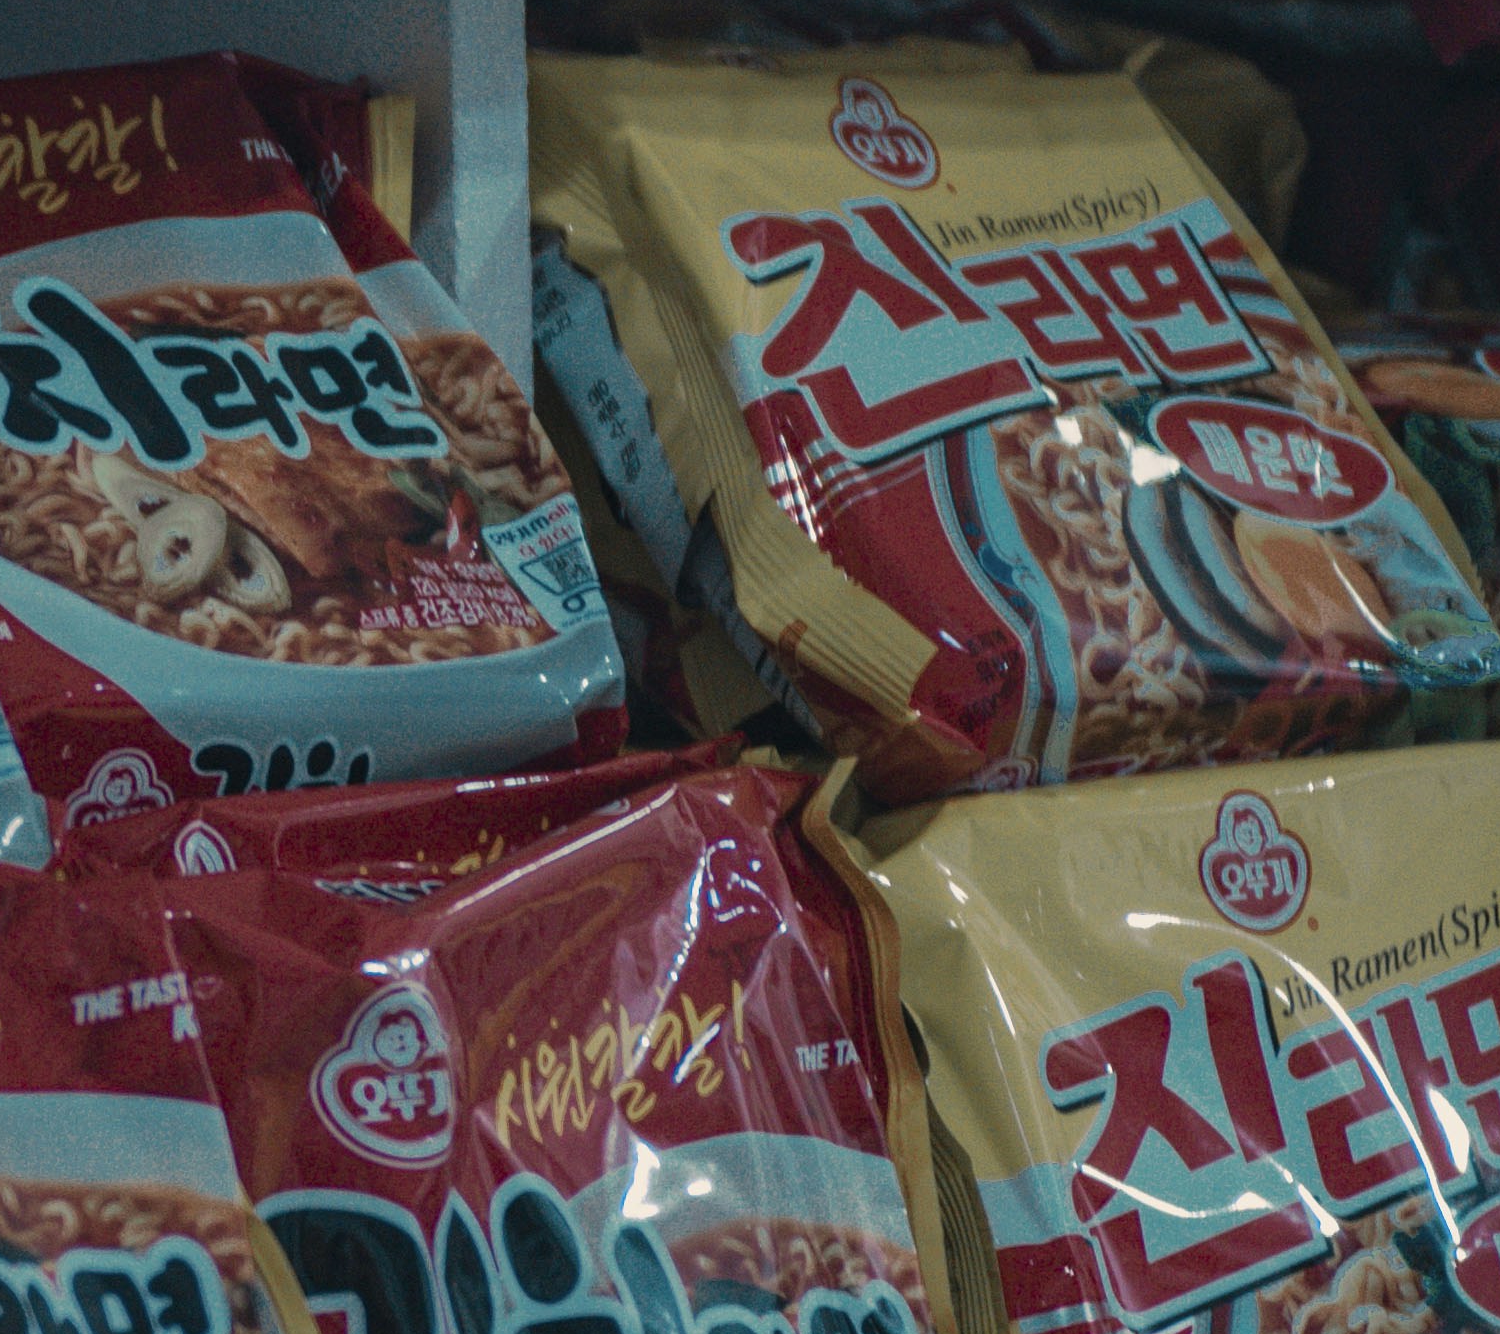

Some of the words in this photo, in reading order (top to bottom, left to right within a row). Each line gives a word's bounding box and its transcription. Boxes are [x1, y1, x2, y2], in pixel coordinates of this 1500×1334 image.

[936, 215, 972, 252] Jin
[976, 179, 1163, 247] Ramen(Spicy)
[719, 195, 1275, 467] 진라면
[1192, 417, 1360, 502] 매운맛
[72, 990, 124, 1025] THE
